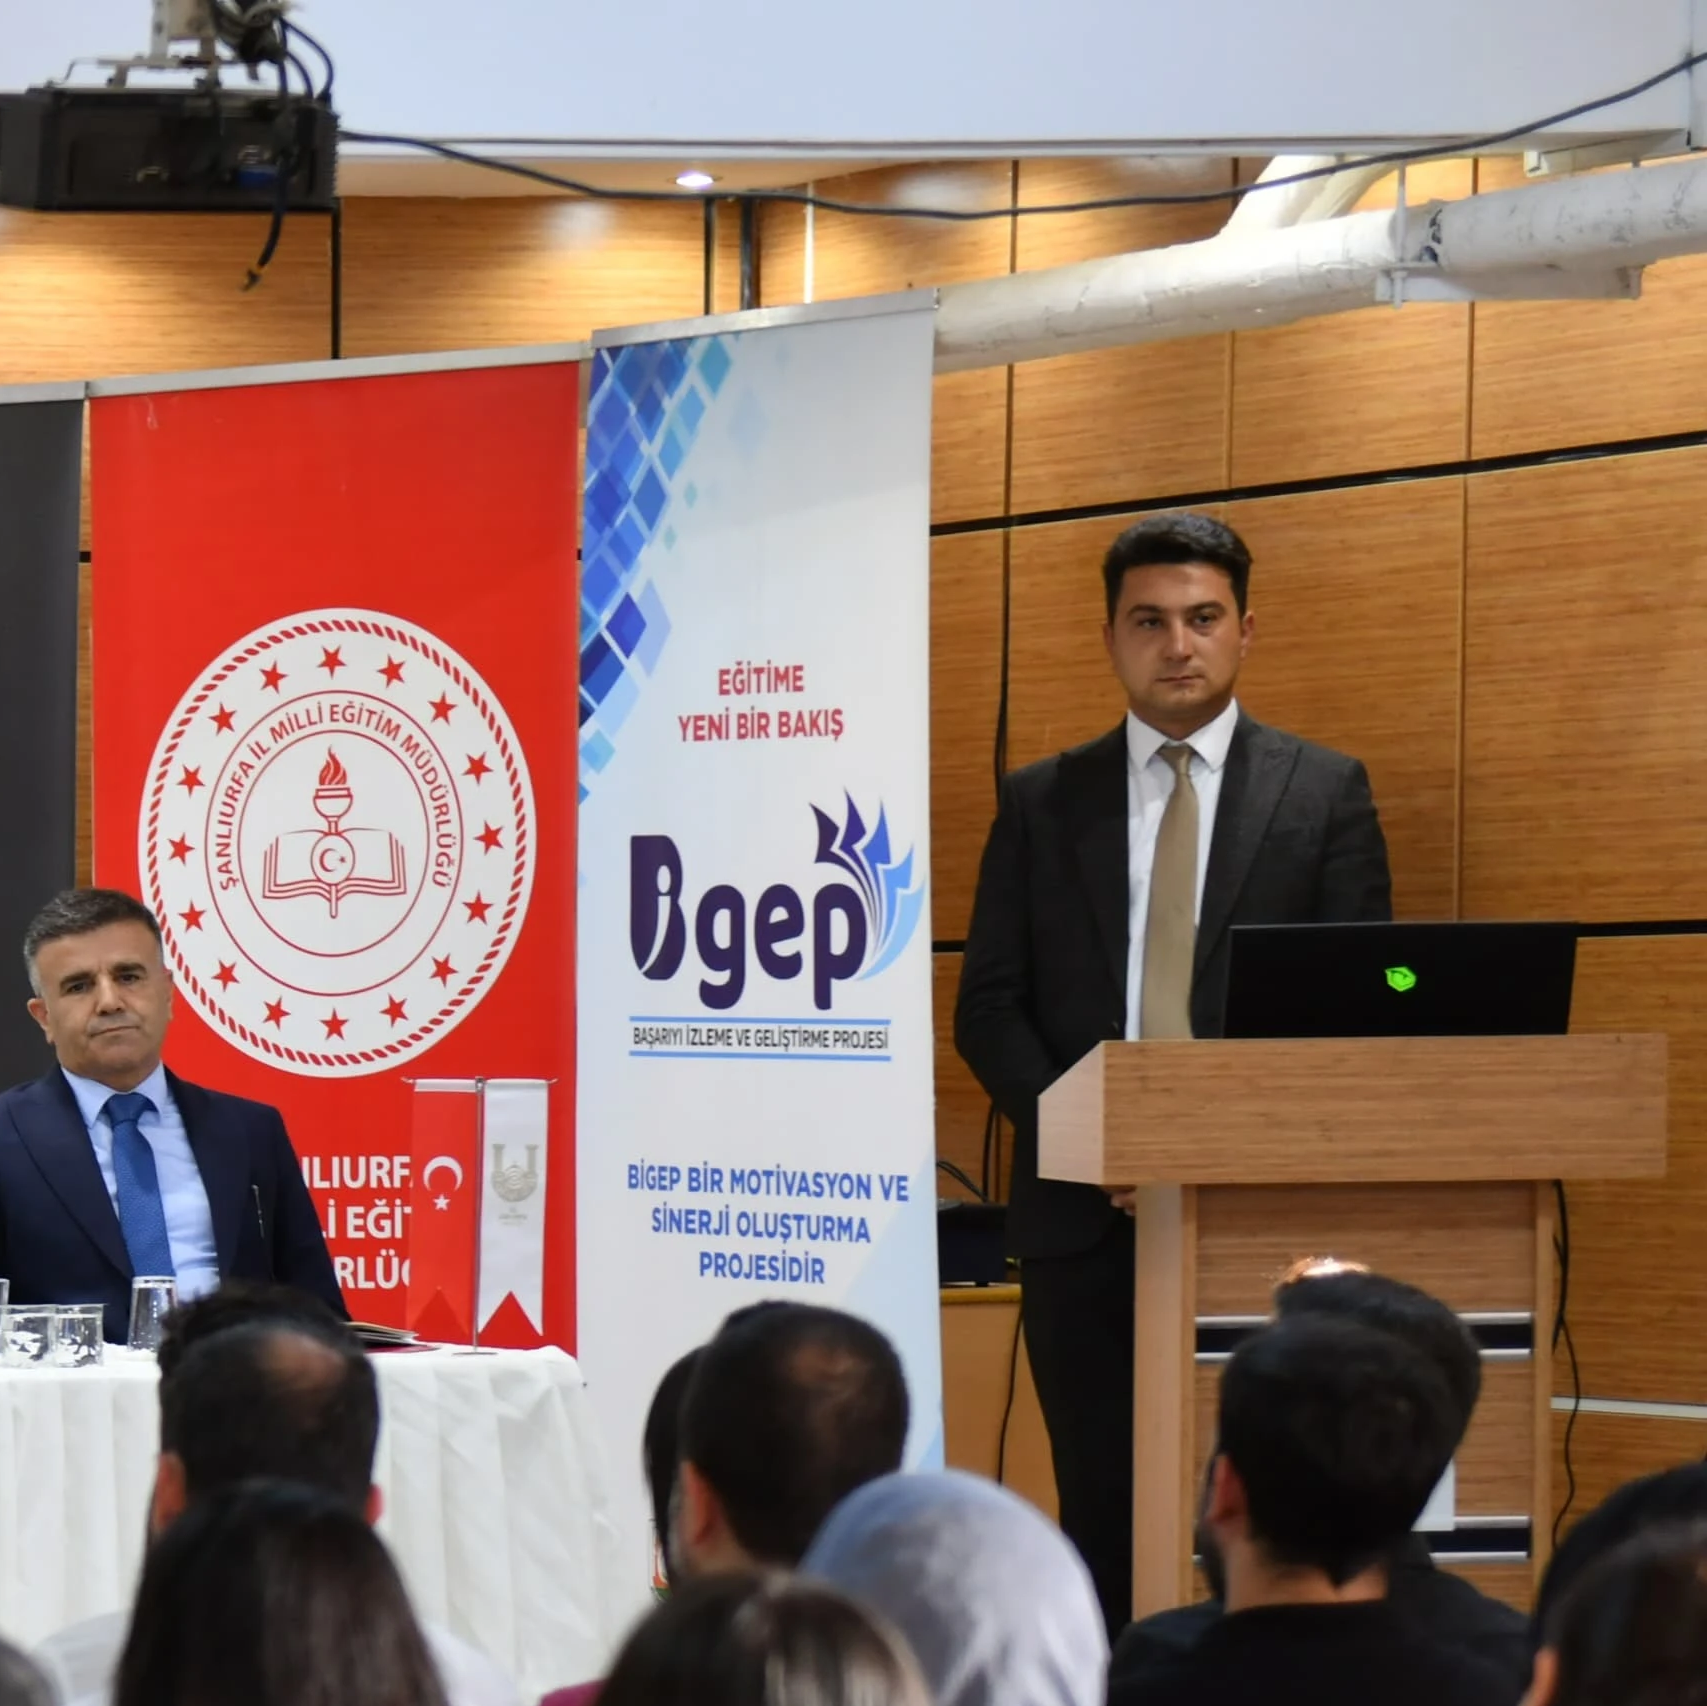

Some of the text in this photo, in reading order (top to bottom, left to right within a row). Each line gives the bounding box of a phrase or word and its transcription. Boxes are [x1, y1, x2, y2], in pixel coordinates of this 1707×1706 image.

[718, 659, 805, 696] EĞİTİME
[678, 705, 844, 742] YENİ BİR BAKIŞ
[215, 700, 457, 891] ŞANLIURFA İL MİLLİ EĞİTİM MÜDÜRLÜĞÜ
[633, 1024, 889, 1052] BAŞARIYI İZLEME VE GELİŞTİRME PROJESİ
[628, 1159, 909, 1202] BİGEP BİR MOTİVASYON VE
[652, 1202, 872, 1244] SİNERJİ OLUŞTURMA
[699, 1250, 825, 1284] PROJESİDİR
